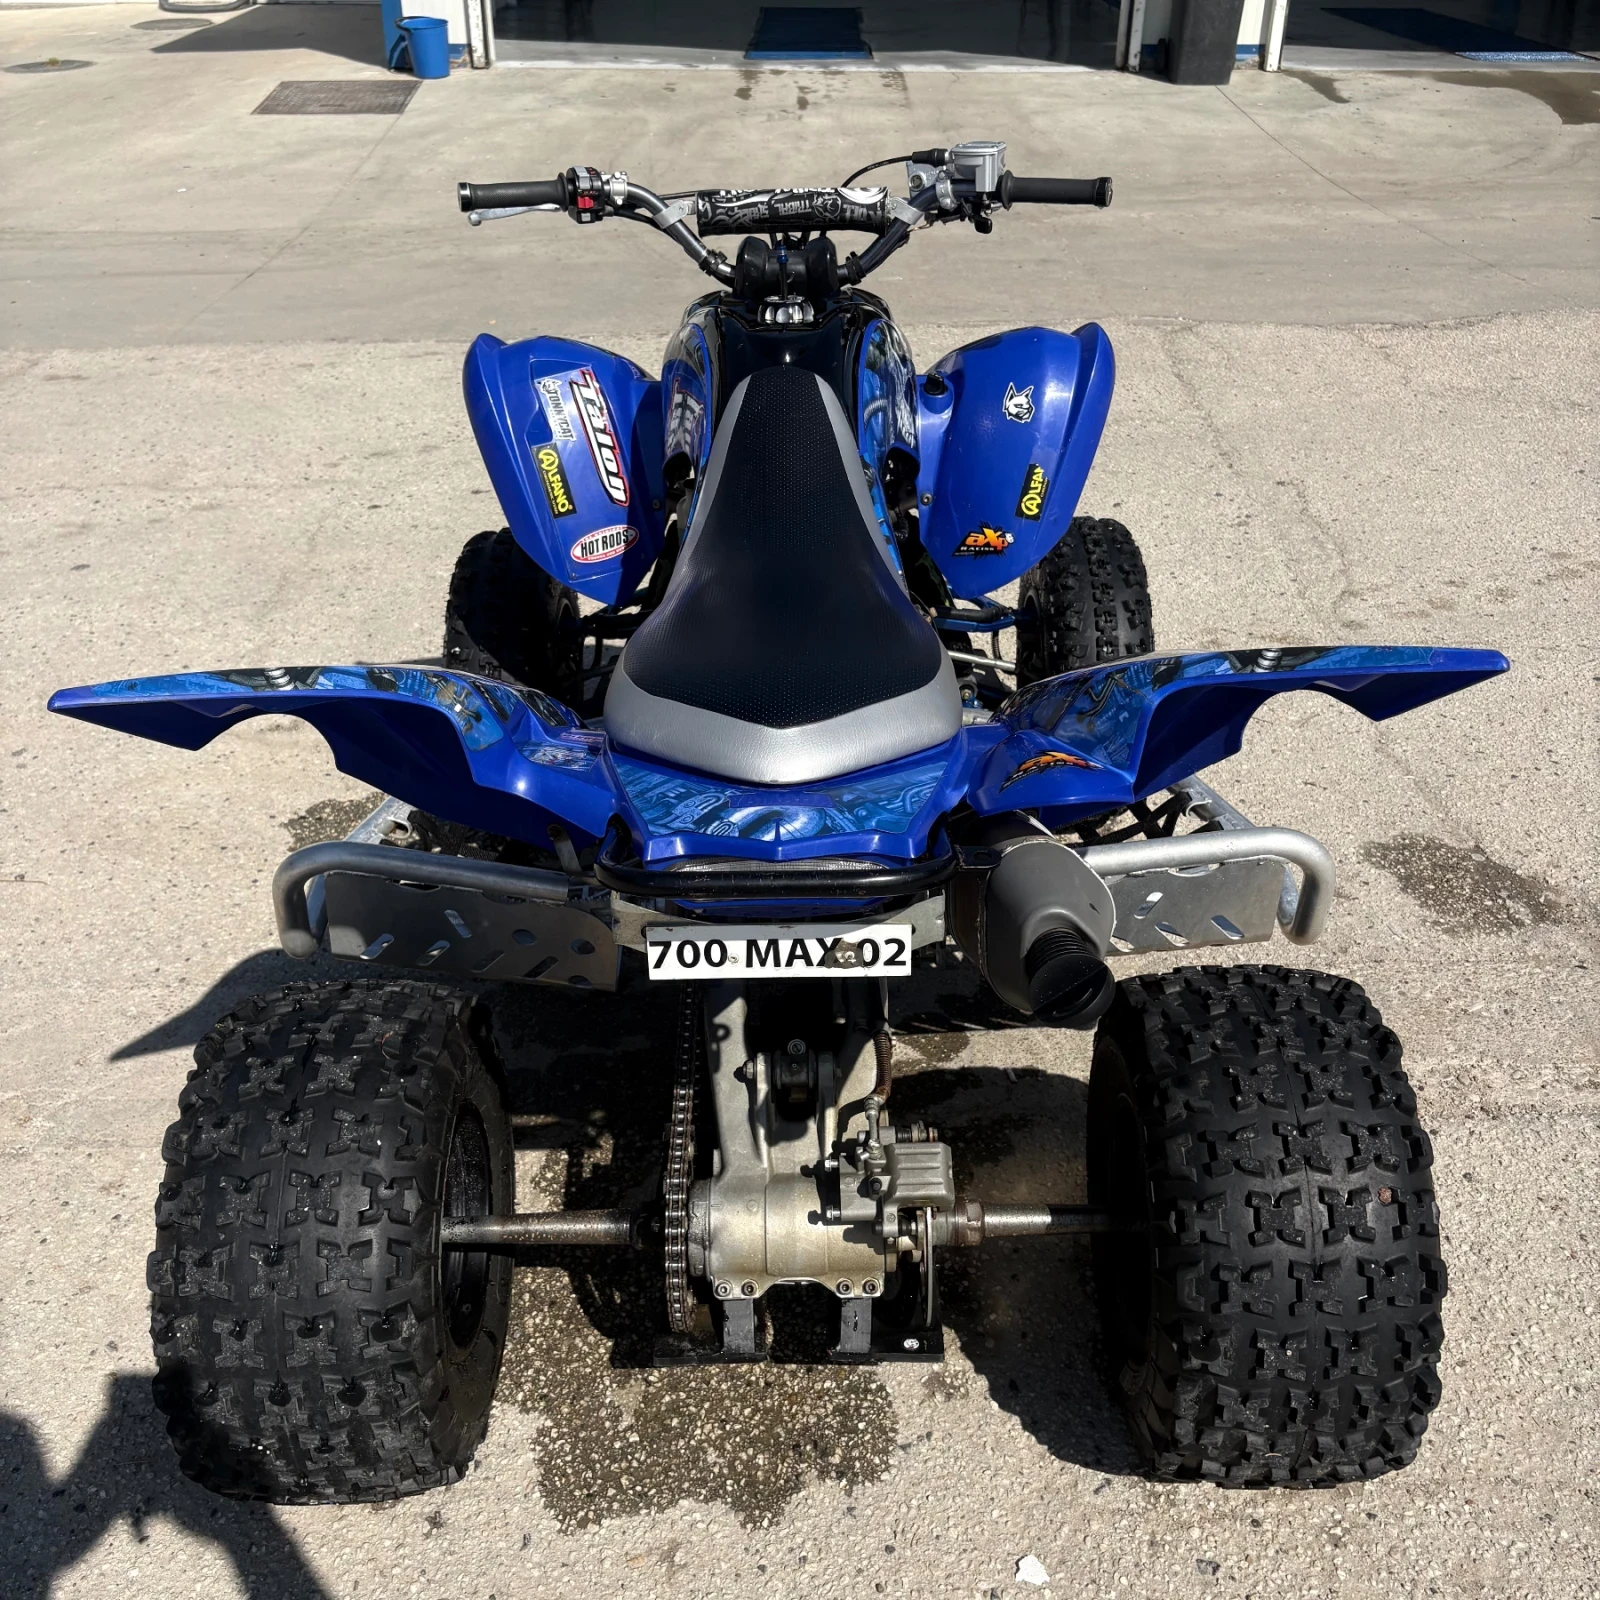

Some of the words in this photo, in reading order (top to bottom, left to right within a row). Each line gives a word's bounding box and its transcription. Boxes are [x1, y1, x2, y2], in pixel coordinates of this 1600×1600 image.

[538, 449, 569, 513] ALFANO
[580, 538, 600, 558] HOT
[601, 529, 629, 551] RODS
[648, 940, 728, 969] 700
[745, 937, 843, 969] MAX
[856, 938, 907, 968] 02
